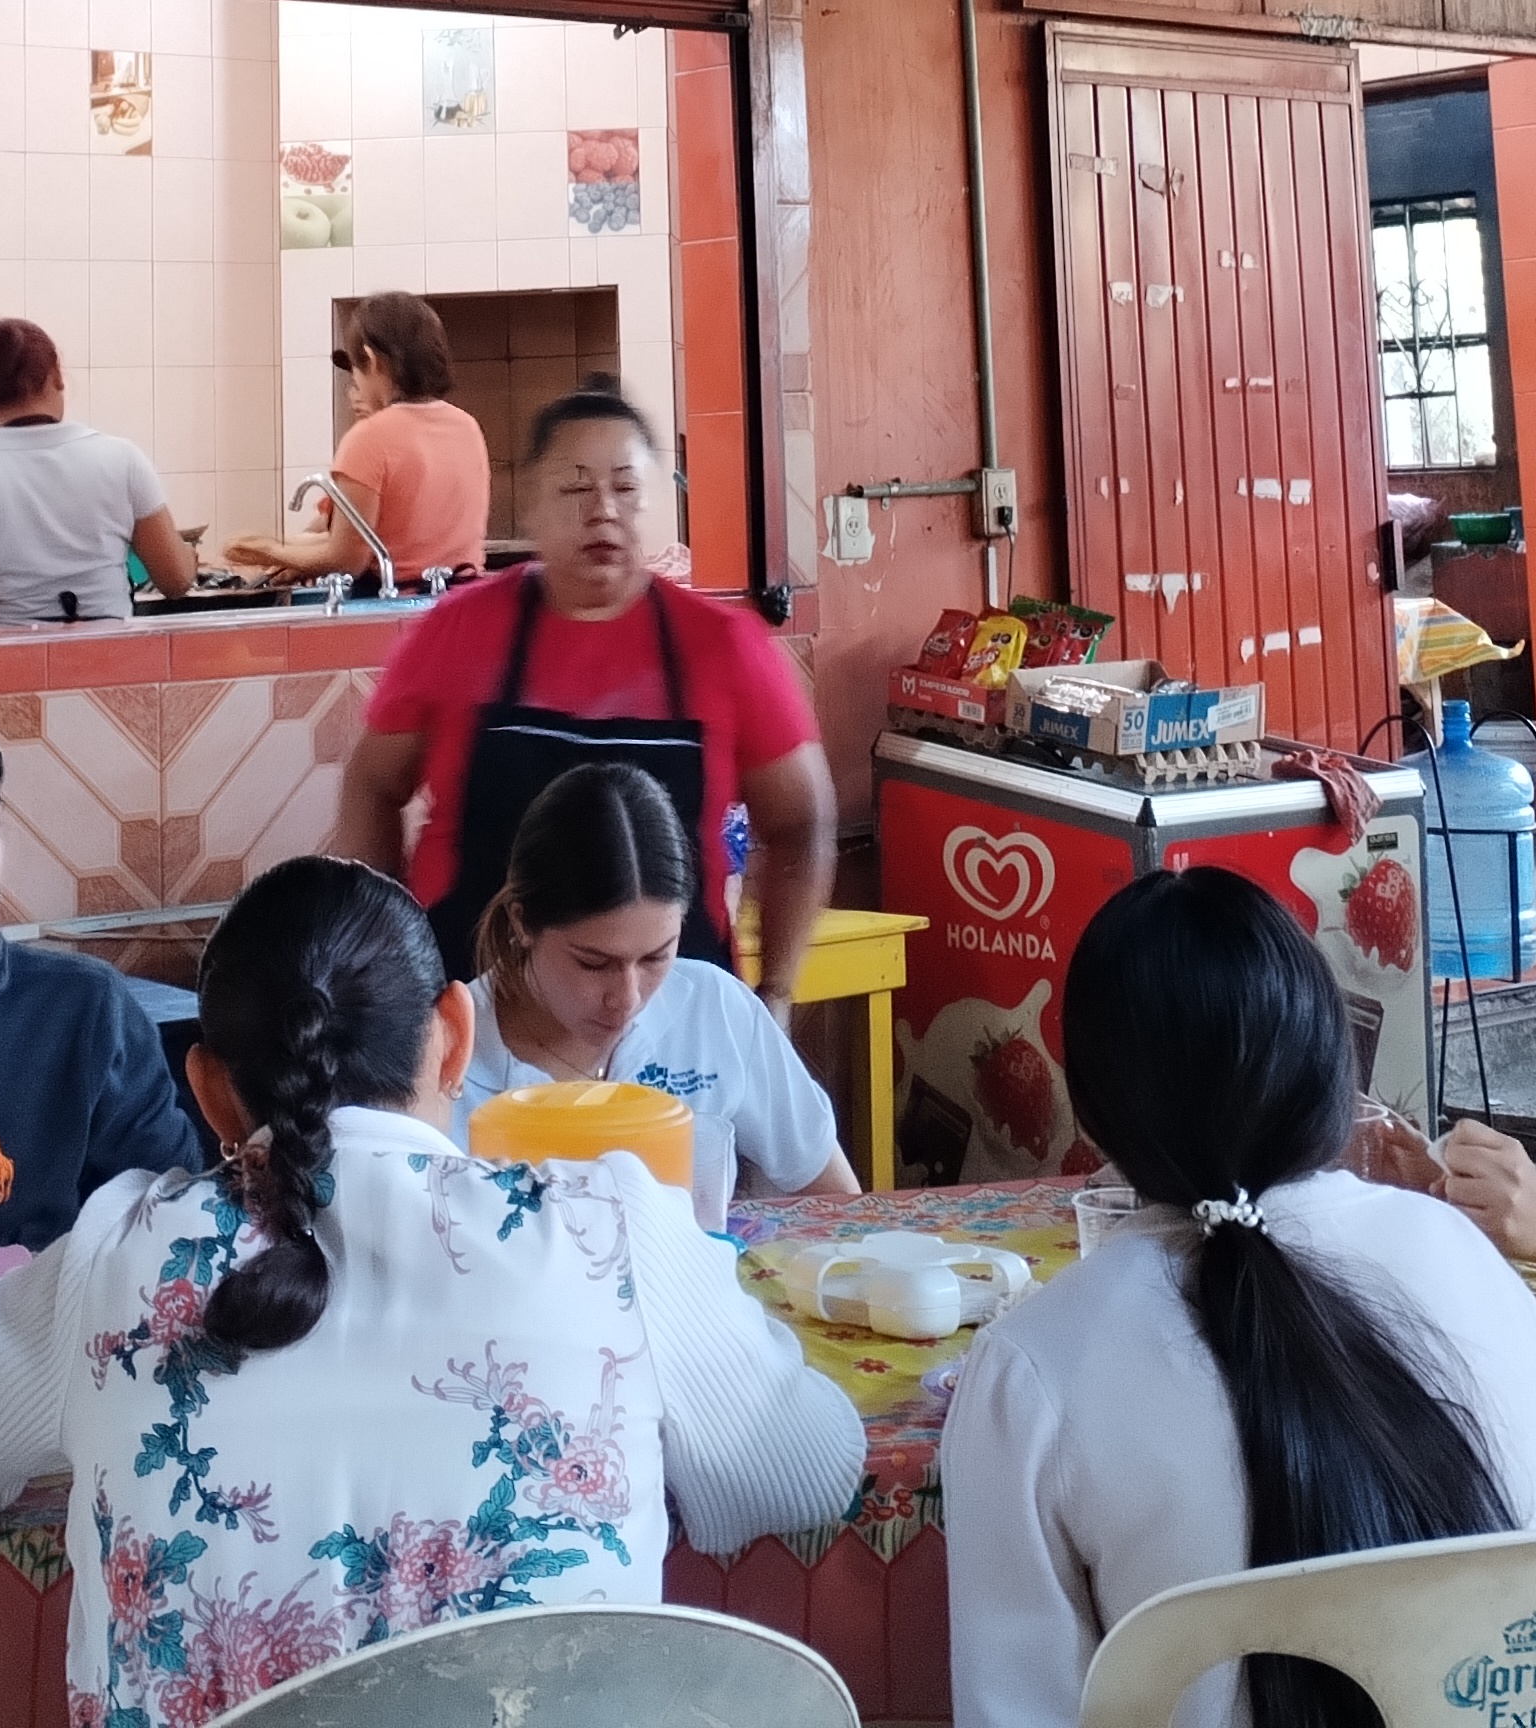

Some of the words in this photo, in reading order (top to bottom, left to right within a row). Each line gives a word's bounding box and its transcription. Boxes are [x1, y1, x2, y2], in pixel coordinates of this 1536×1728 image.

[1039, 718, 1080, 741] JUMEX
[1123, 711, 1144, 731] 50
[1151, 718, 1210, 745] JUMEX
[946, 923, 1057, 963] HOLANDA
